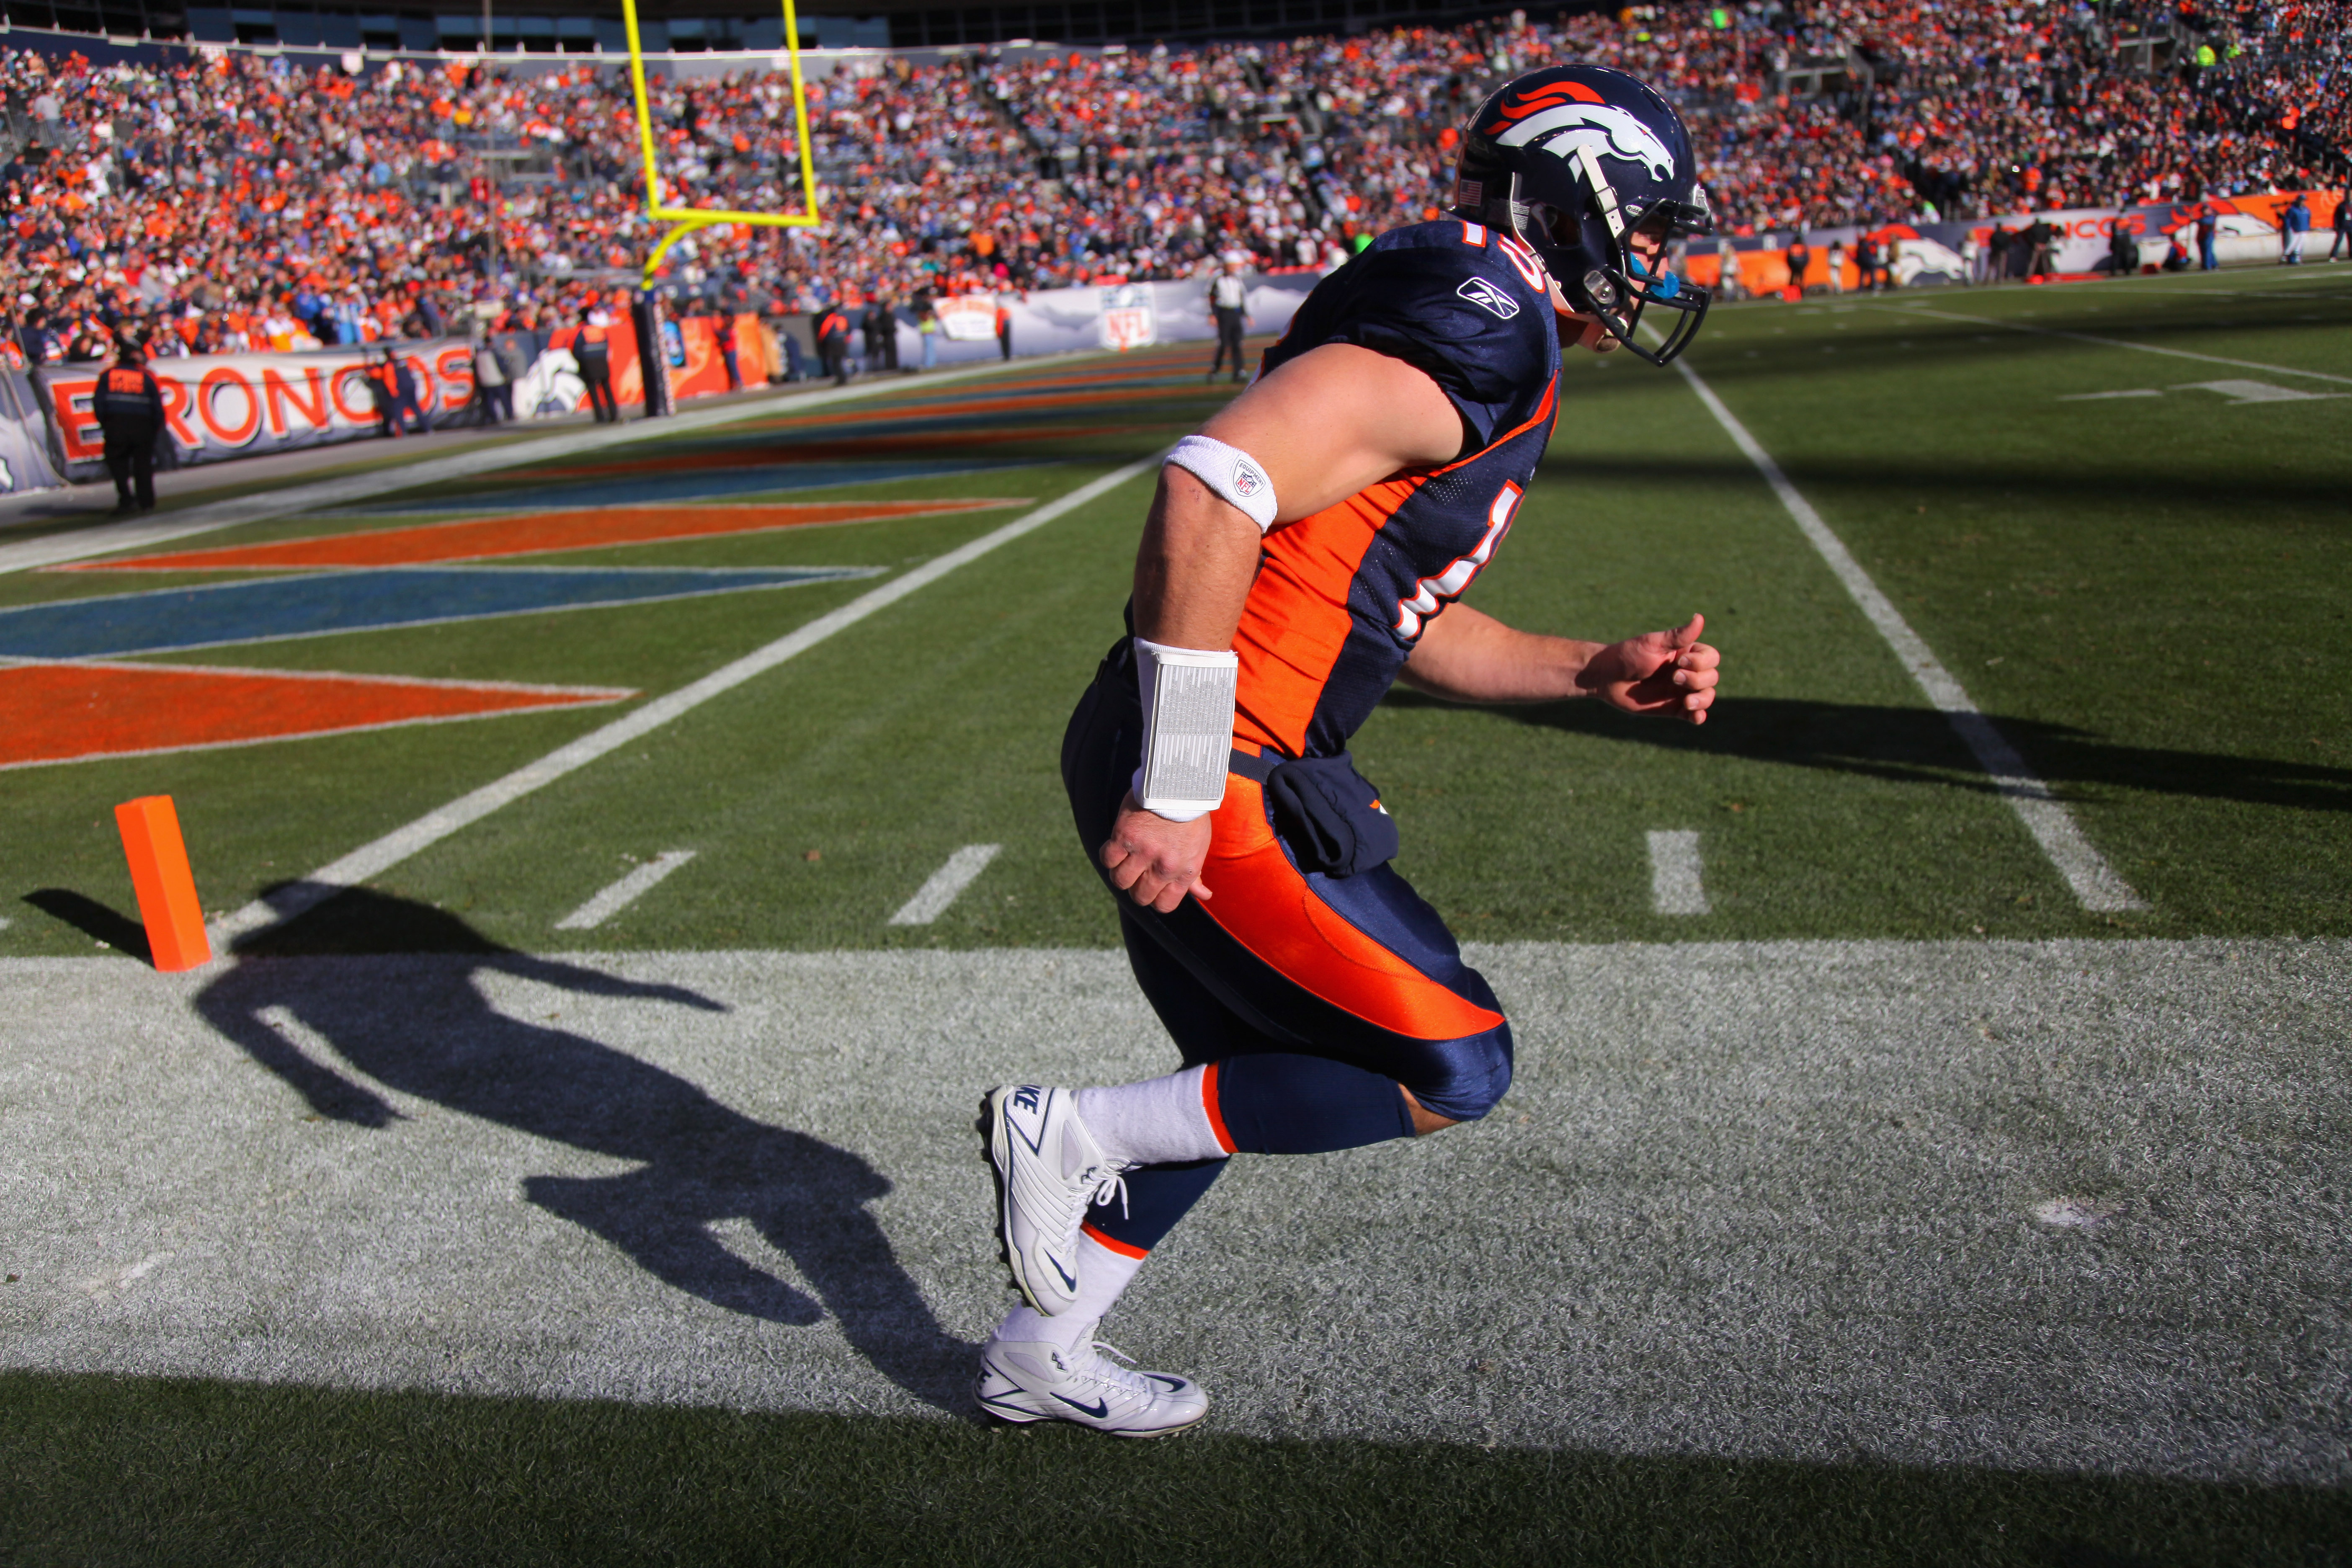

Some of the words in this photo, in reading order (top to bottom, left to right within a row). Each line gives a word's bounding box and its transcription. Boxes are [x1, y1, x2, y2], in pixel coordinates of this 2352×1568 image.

[1627, 205, 1643, 215] Ridde
[1239, 463, 1264, 486] EQUIPMENT
[1238, 477, 1251, 493] NFL
